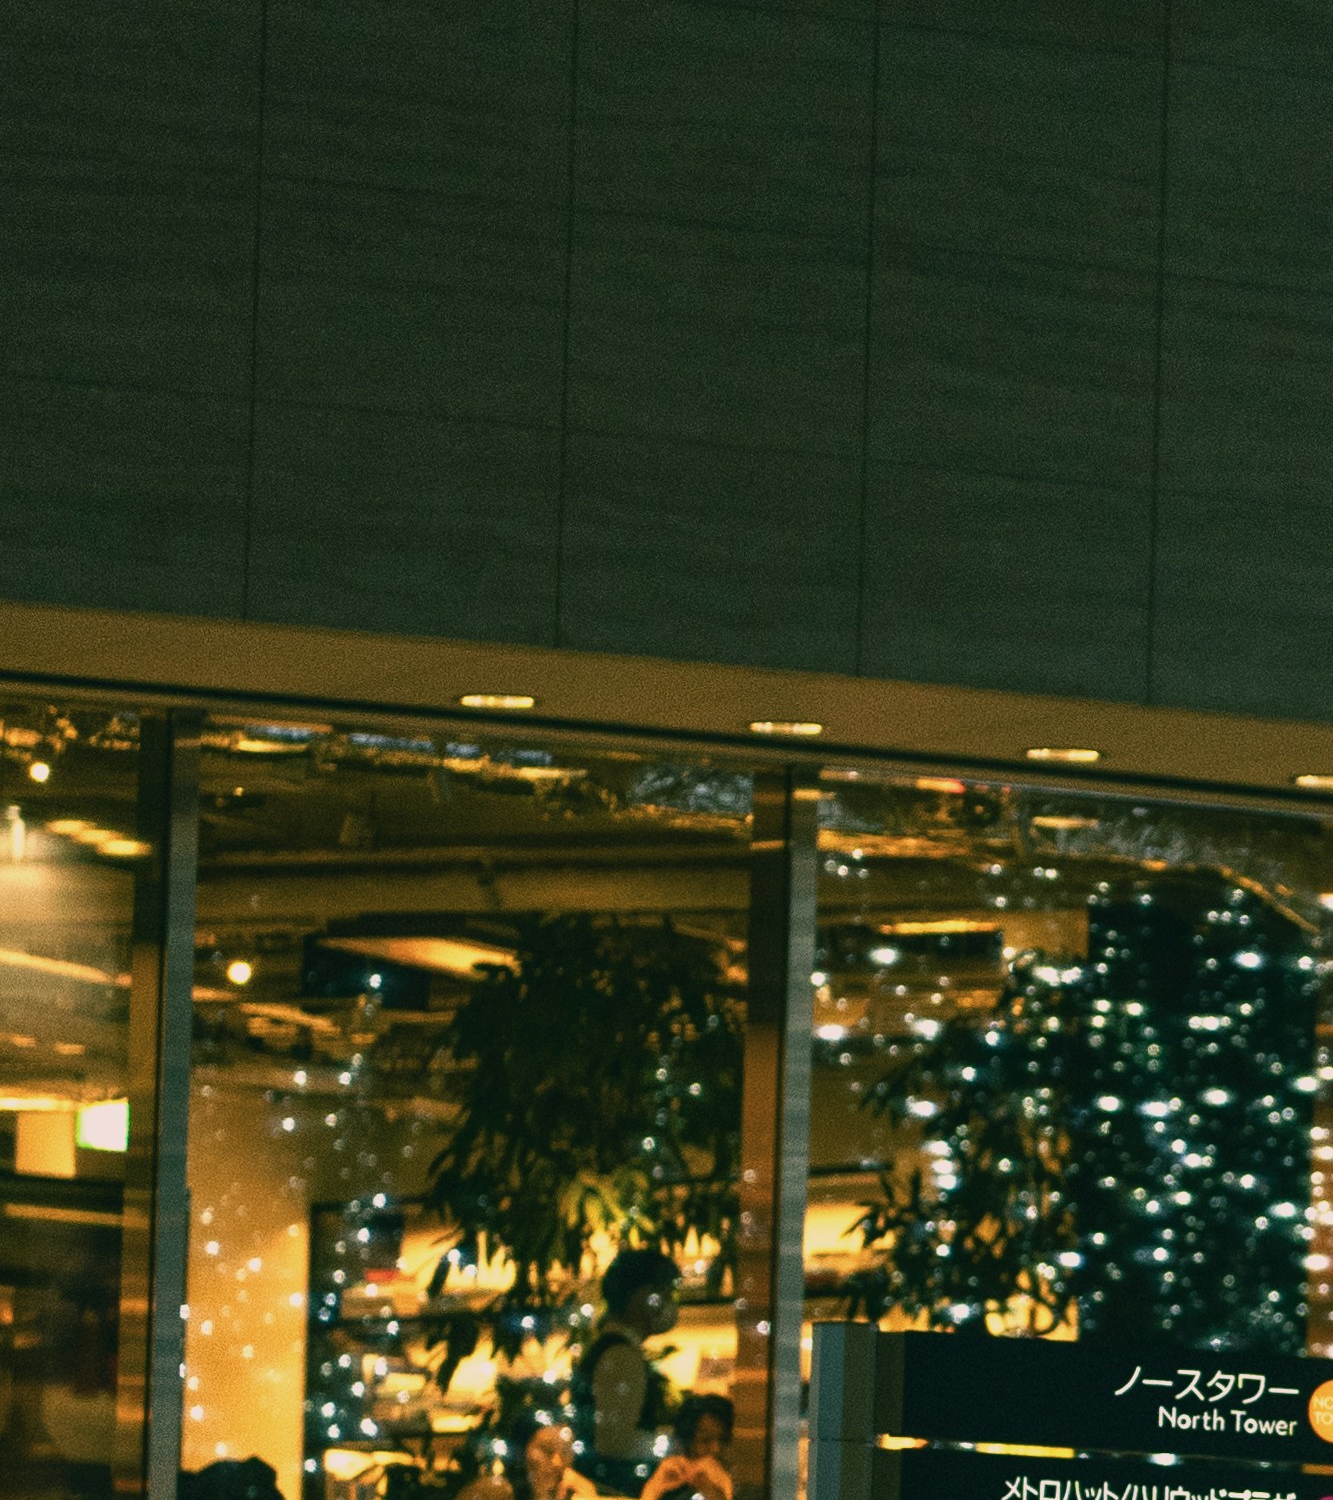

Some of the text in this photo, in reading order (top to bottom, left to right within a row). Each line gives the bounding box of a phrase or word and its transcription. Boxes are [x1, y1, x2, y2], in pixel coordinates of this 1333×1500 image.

[1114, 1365, 1300, 1404] ノースタワー
[1158, 1405, 1298, 1437] North Tower
